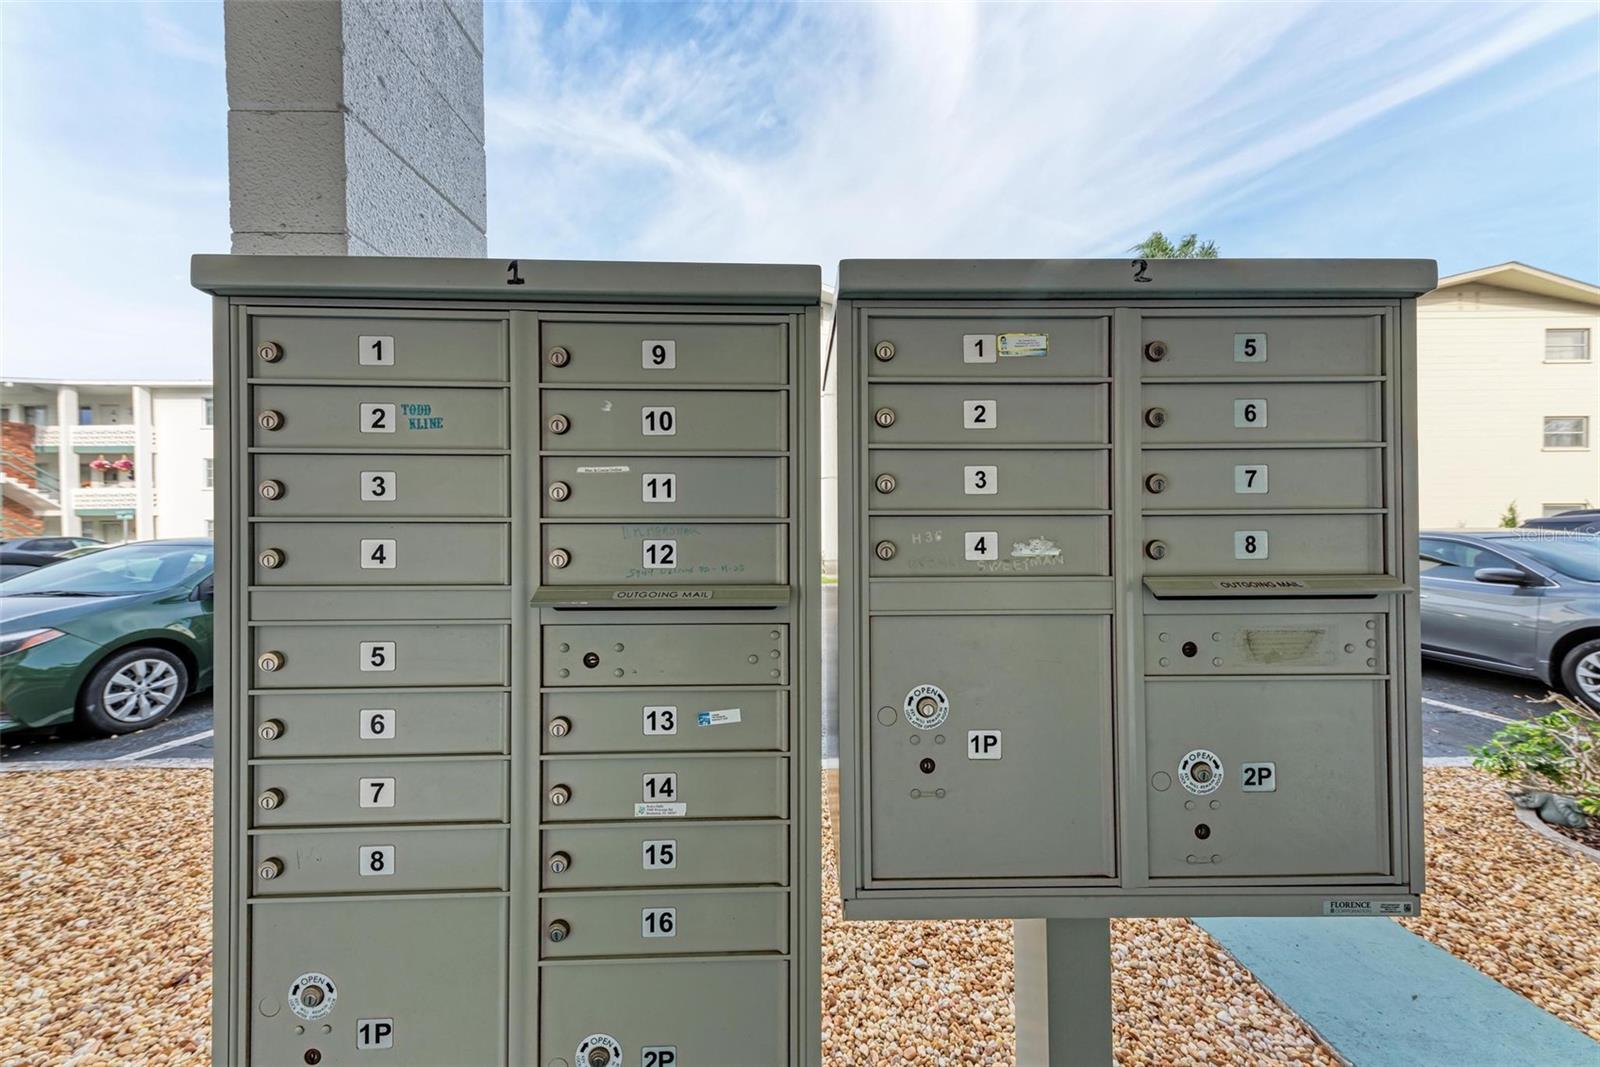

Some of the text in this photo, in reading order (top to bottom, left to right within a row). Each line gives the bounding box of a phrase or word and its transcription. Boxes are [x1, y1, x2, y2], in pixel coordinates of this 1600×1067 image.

[507, 260, 525, 285] 1
[1131, 259, 1152, 283] 2
[371, 339, 382, 361] 1
[651, 344, 666, 366] 9
[974, 339, 984, 358] 1
[1243, 338, 1257, 358] 5
[371, 408, 386, 429] 2
[400, 404, 432, 416] TODD
[973, 404, 987, 424] 2
[1243, 403, 1257, 423] 6
[408, 417, 444, 430] KLINE
[645, 410, 673, 432] 10
[371, 475, 386, 497] 3
[647, 478, 672, 499] 11
[975, 470, 987, 489] 3
[1244, 469, 1258, 488] 7
[370, 543, 387, 565] 4
[646, 544, 674, 565] 12
[974, 536, 987, 555] 4
[1244, 535, 1257, 554] 8
[617, 591, 709, 599] OUTGOING MAIL
[1220, 581, 1276, 589] OUTGOING
[370, 646, 386, 667] 5
[914, 687, 939, 697] OPEN
[370, 714, 385, 735] 6
[646, 710, 675, 731] 13
[970, 734, 998, 754] 1P
[1189, 752, 1214, 762] OPEN
[1243, 767, 1272, 787] 2P
[370, 782, 385, 803] 7
[645, 777, 674, 798] 14
[370, 850, 385, 872] 8
[645, 844, 674, 866] 15
[1330, 901, 1371, 909] FLORENCE
[644, 911, 674, 933] 16
[301, 976, 326, 986] OPEN
[359, 1022, 392, 1046] 1P
[591, 1036, 614, 1048] OPEN
[644, 1051, 674, 1067] 2P
